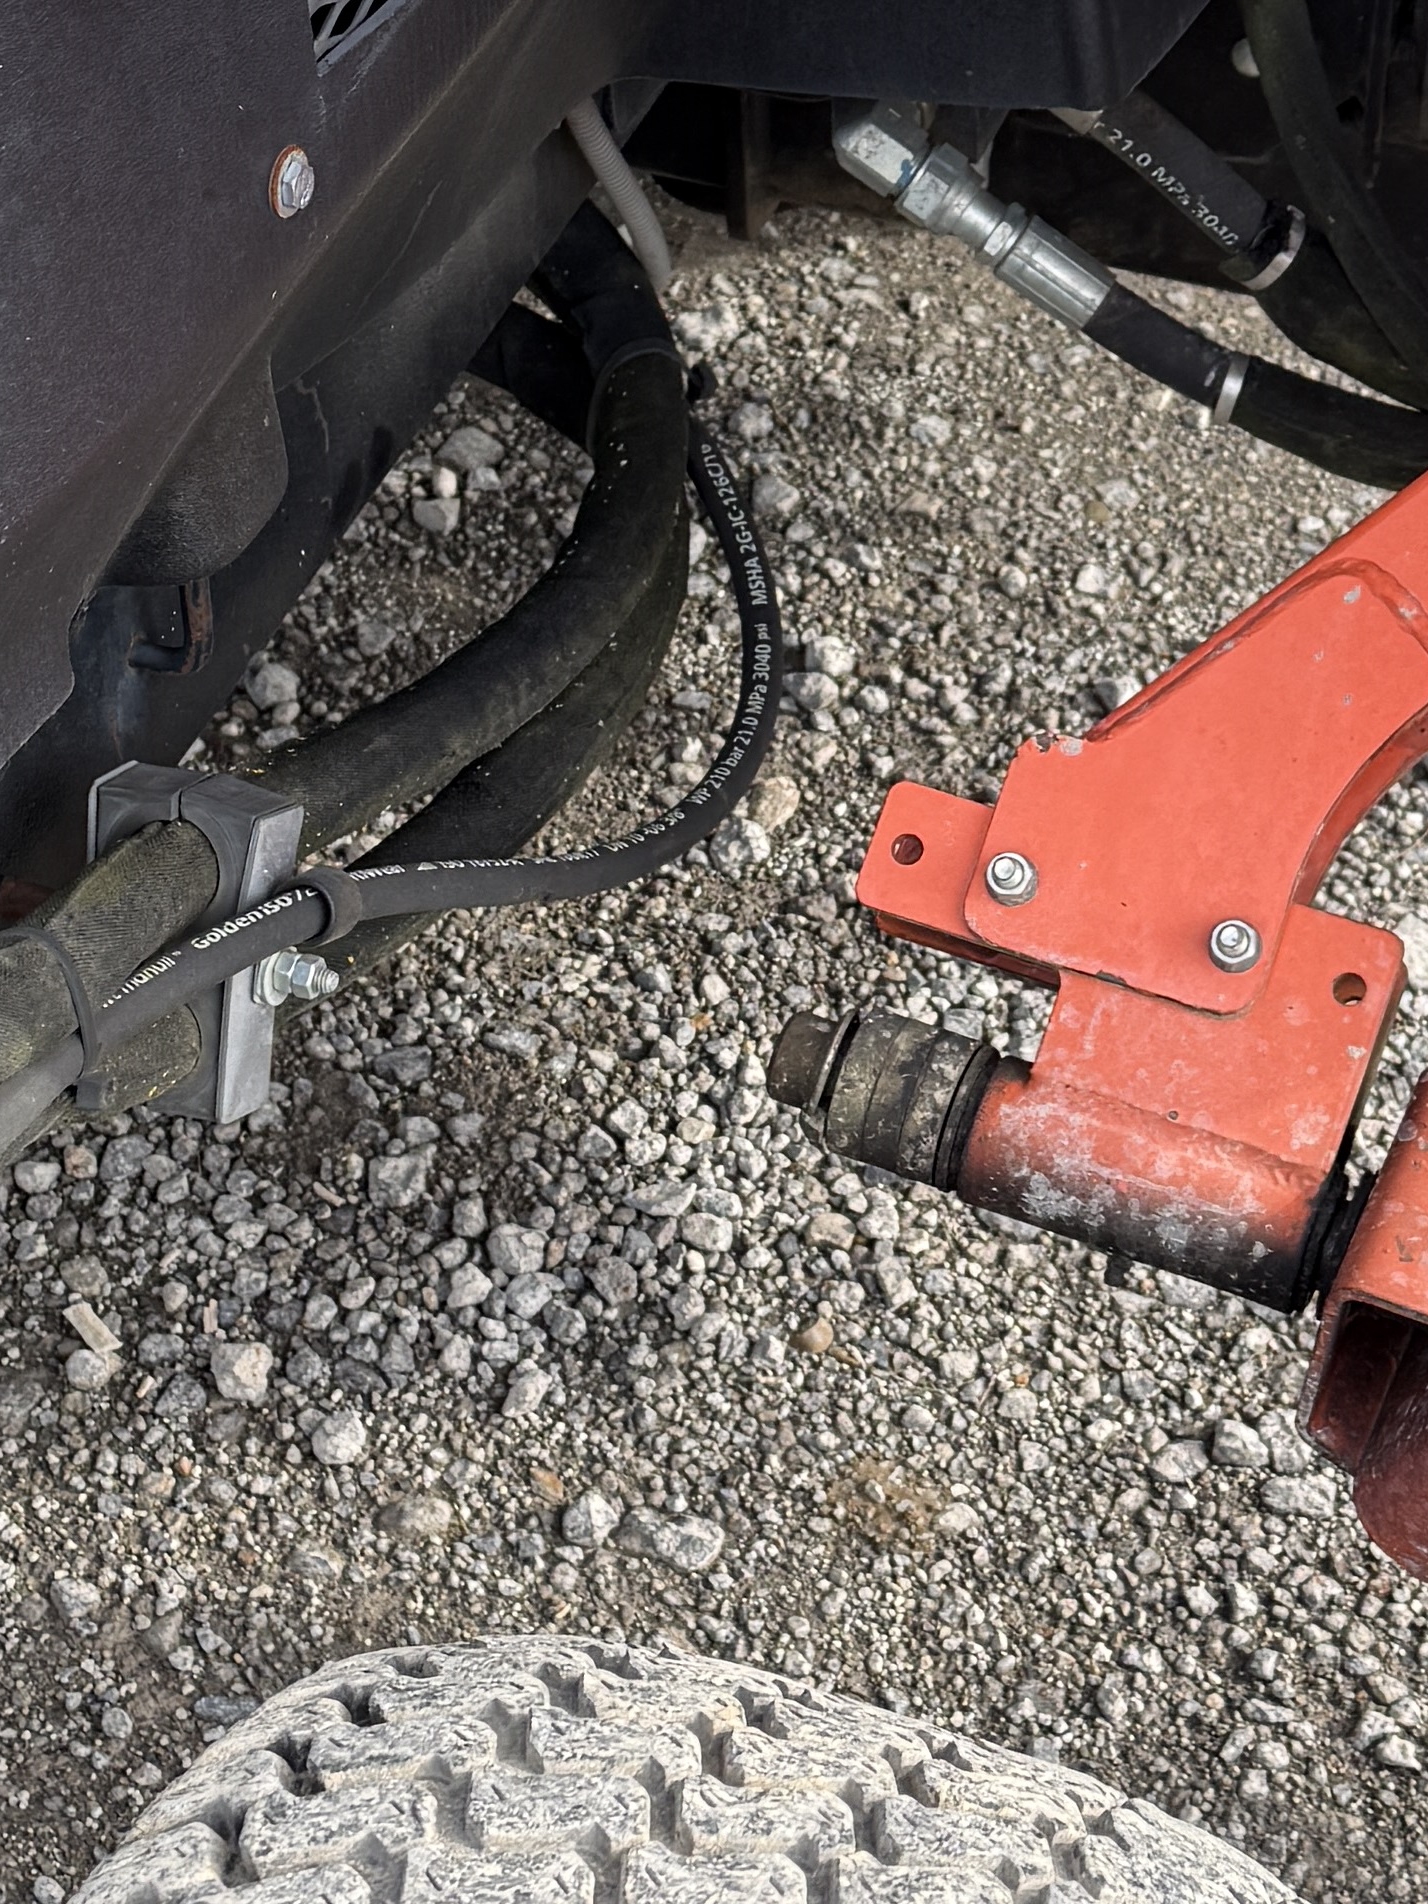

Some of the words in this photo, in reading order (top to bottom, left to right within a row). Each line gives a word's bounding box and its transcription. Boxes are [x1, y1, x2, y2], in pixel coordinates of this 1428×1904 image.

[744, 556, 768, 606] MSHA
[754, 623, 771, 641] psi
[752, 644, 772, 682] 3040
[745, 684, 768, 715] MPa
[733, 716, 759, 745] 21.0
[725, 746, 745, 768] bar
[707, 767, 732, 789] 210
